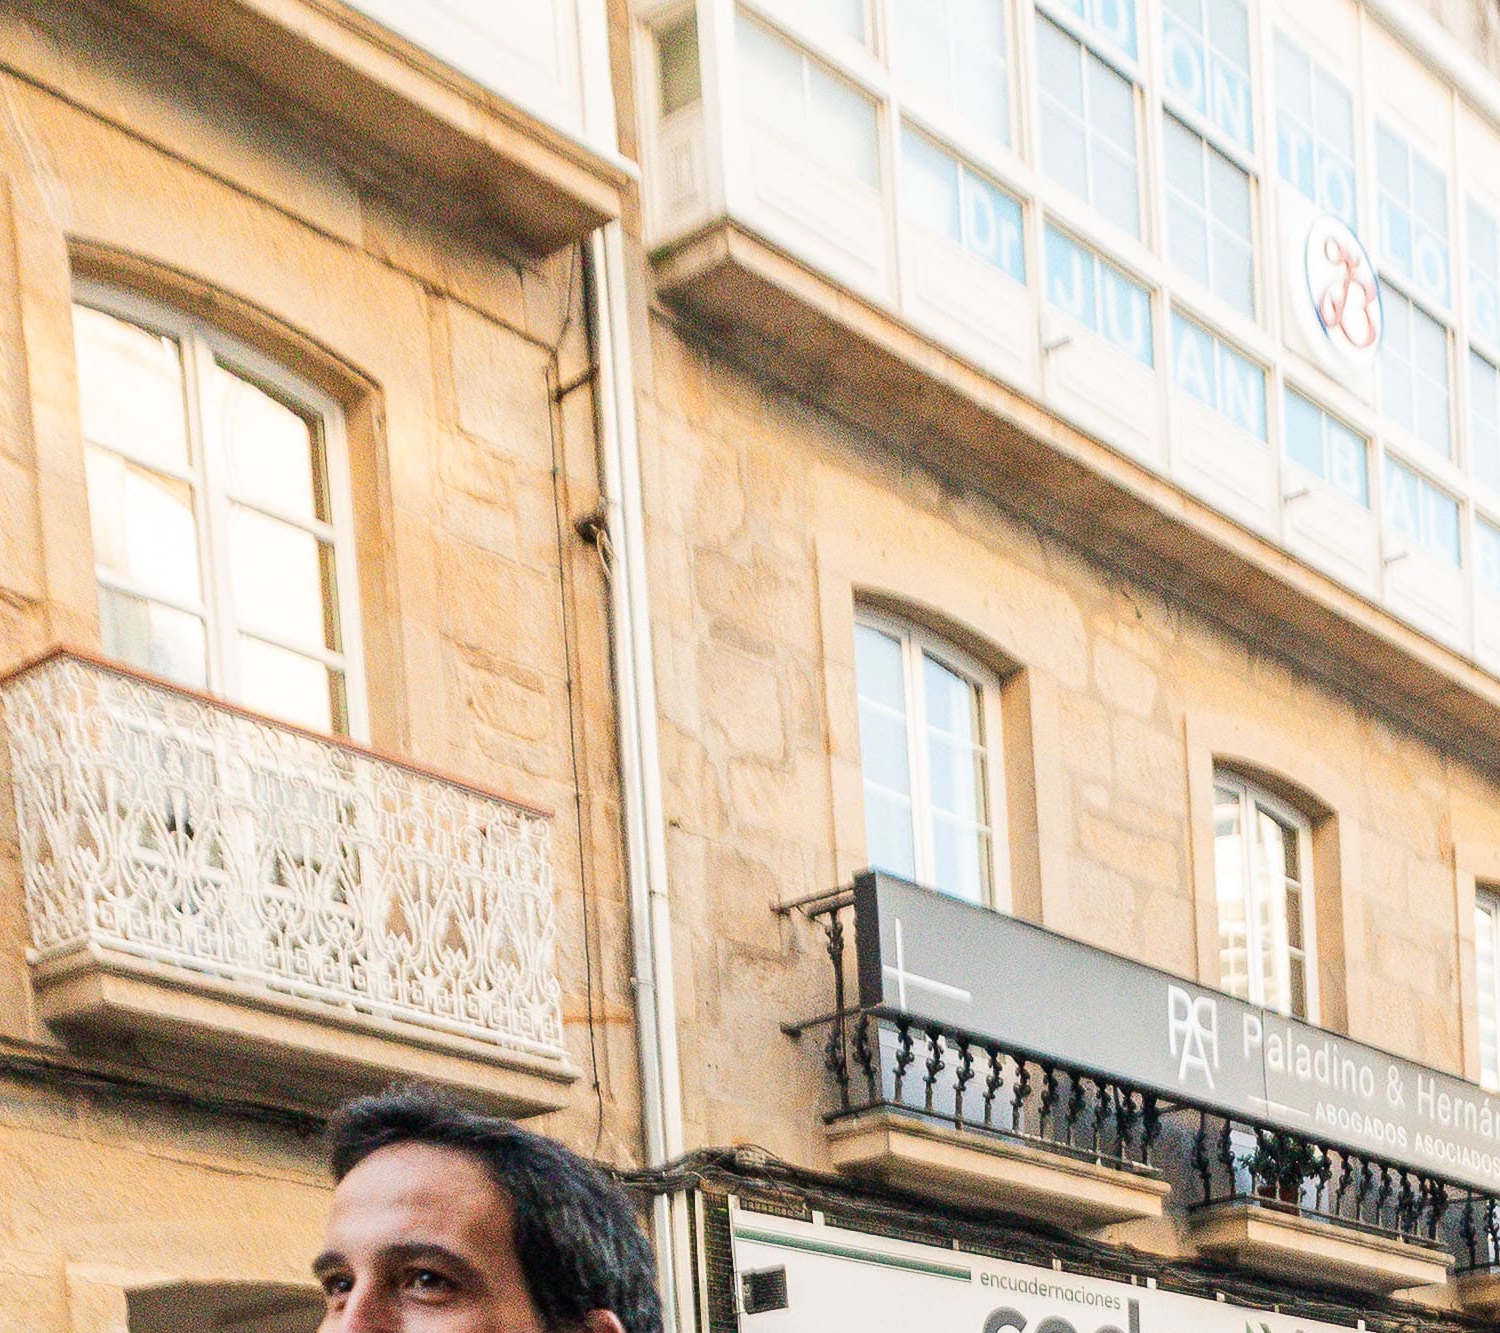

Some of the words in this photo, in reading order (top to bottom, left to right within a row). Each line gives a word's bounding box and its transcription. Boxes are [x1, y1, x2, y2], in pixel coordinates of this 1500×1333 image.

[1054, 250, 1257, 431] JUAN
[1243, 1012, 1374, 1098] Paladino
[1387, 1064, 1406, 1107] &
[1315, 1101, 1408, 1147] ABOGADOS
[980, 1270, 1121, 1310] encuadernaciones
